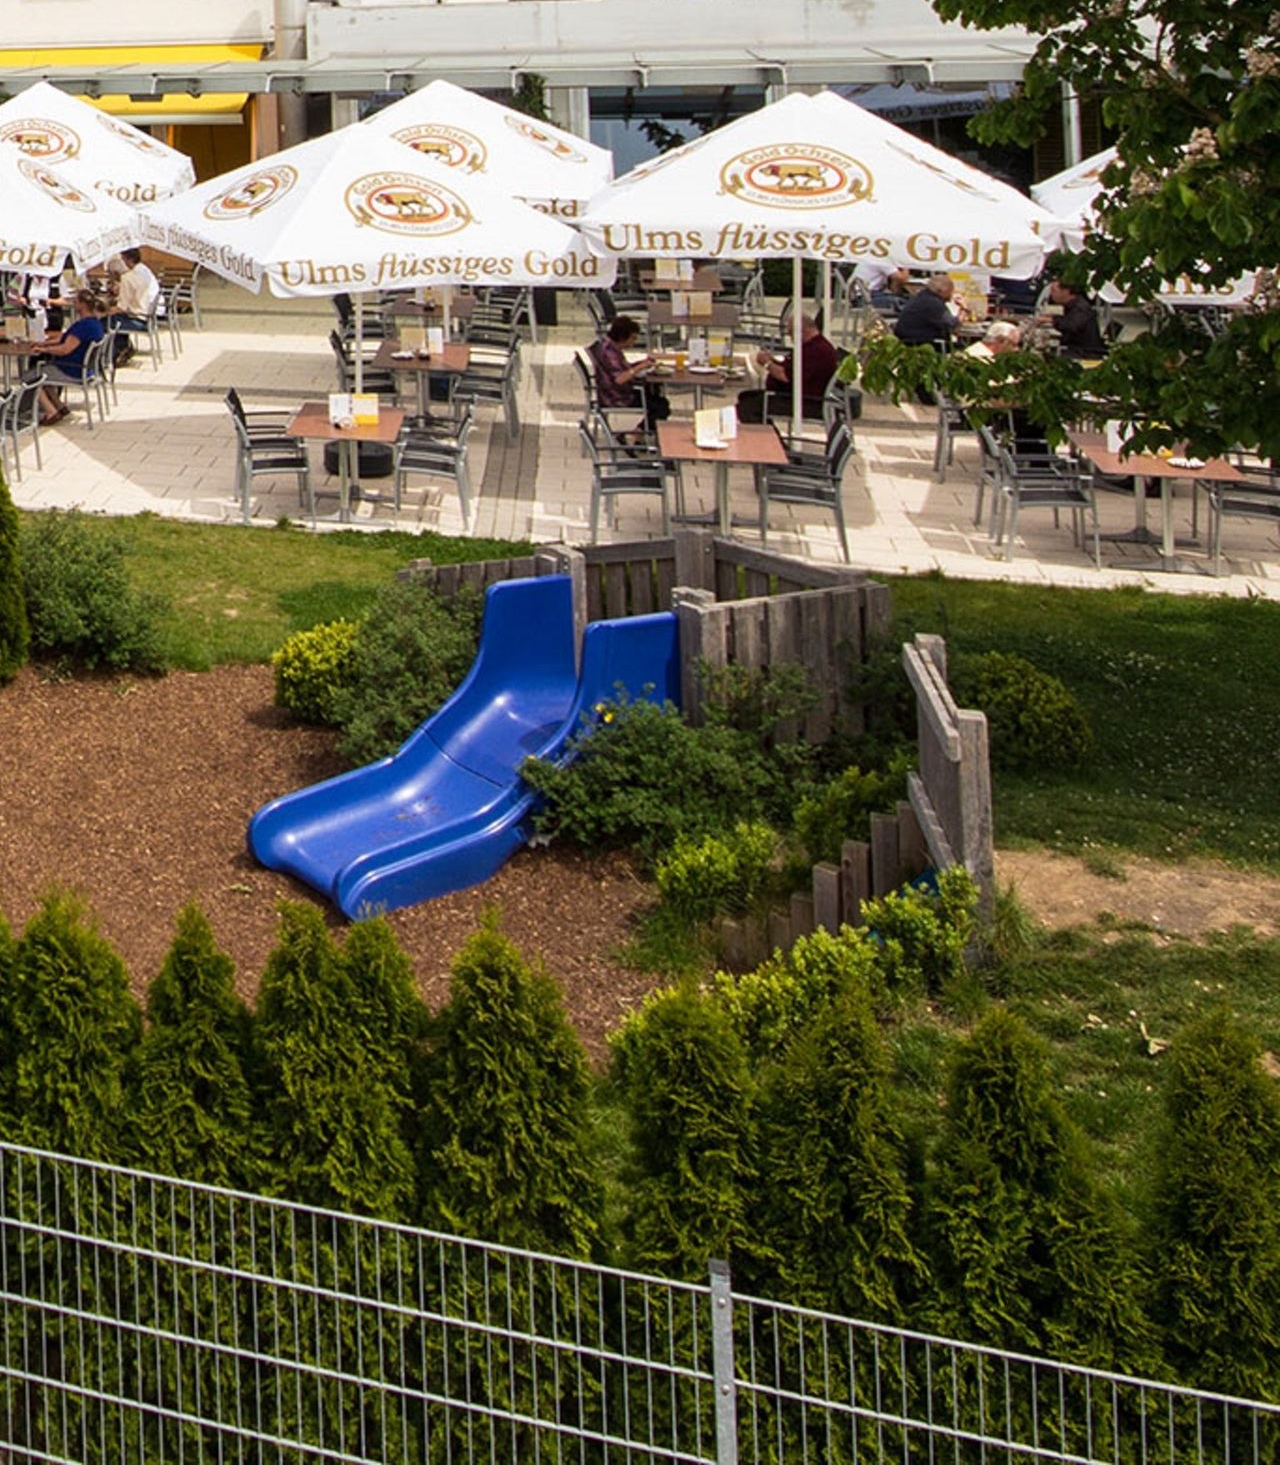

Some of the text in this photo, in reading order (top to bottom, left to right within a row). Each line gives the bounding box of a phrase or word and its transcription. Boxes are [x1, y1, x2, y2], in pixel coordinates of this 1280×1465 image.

[740, 144, 853, 170] Gold Ochsen
[512, 196, 578, 217] old
[220, 244, 256, 282] Gold
[600, 221, 1011, 269] Ulms flüssiges Gold
[277, 249, 600, 287] Ulms flüssiges Gold
